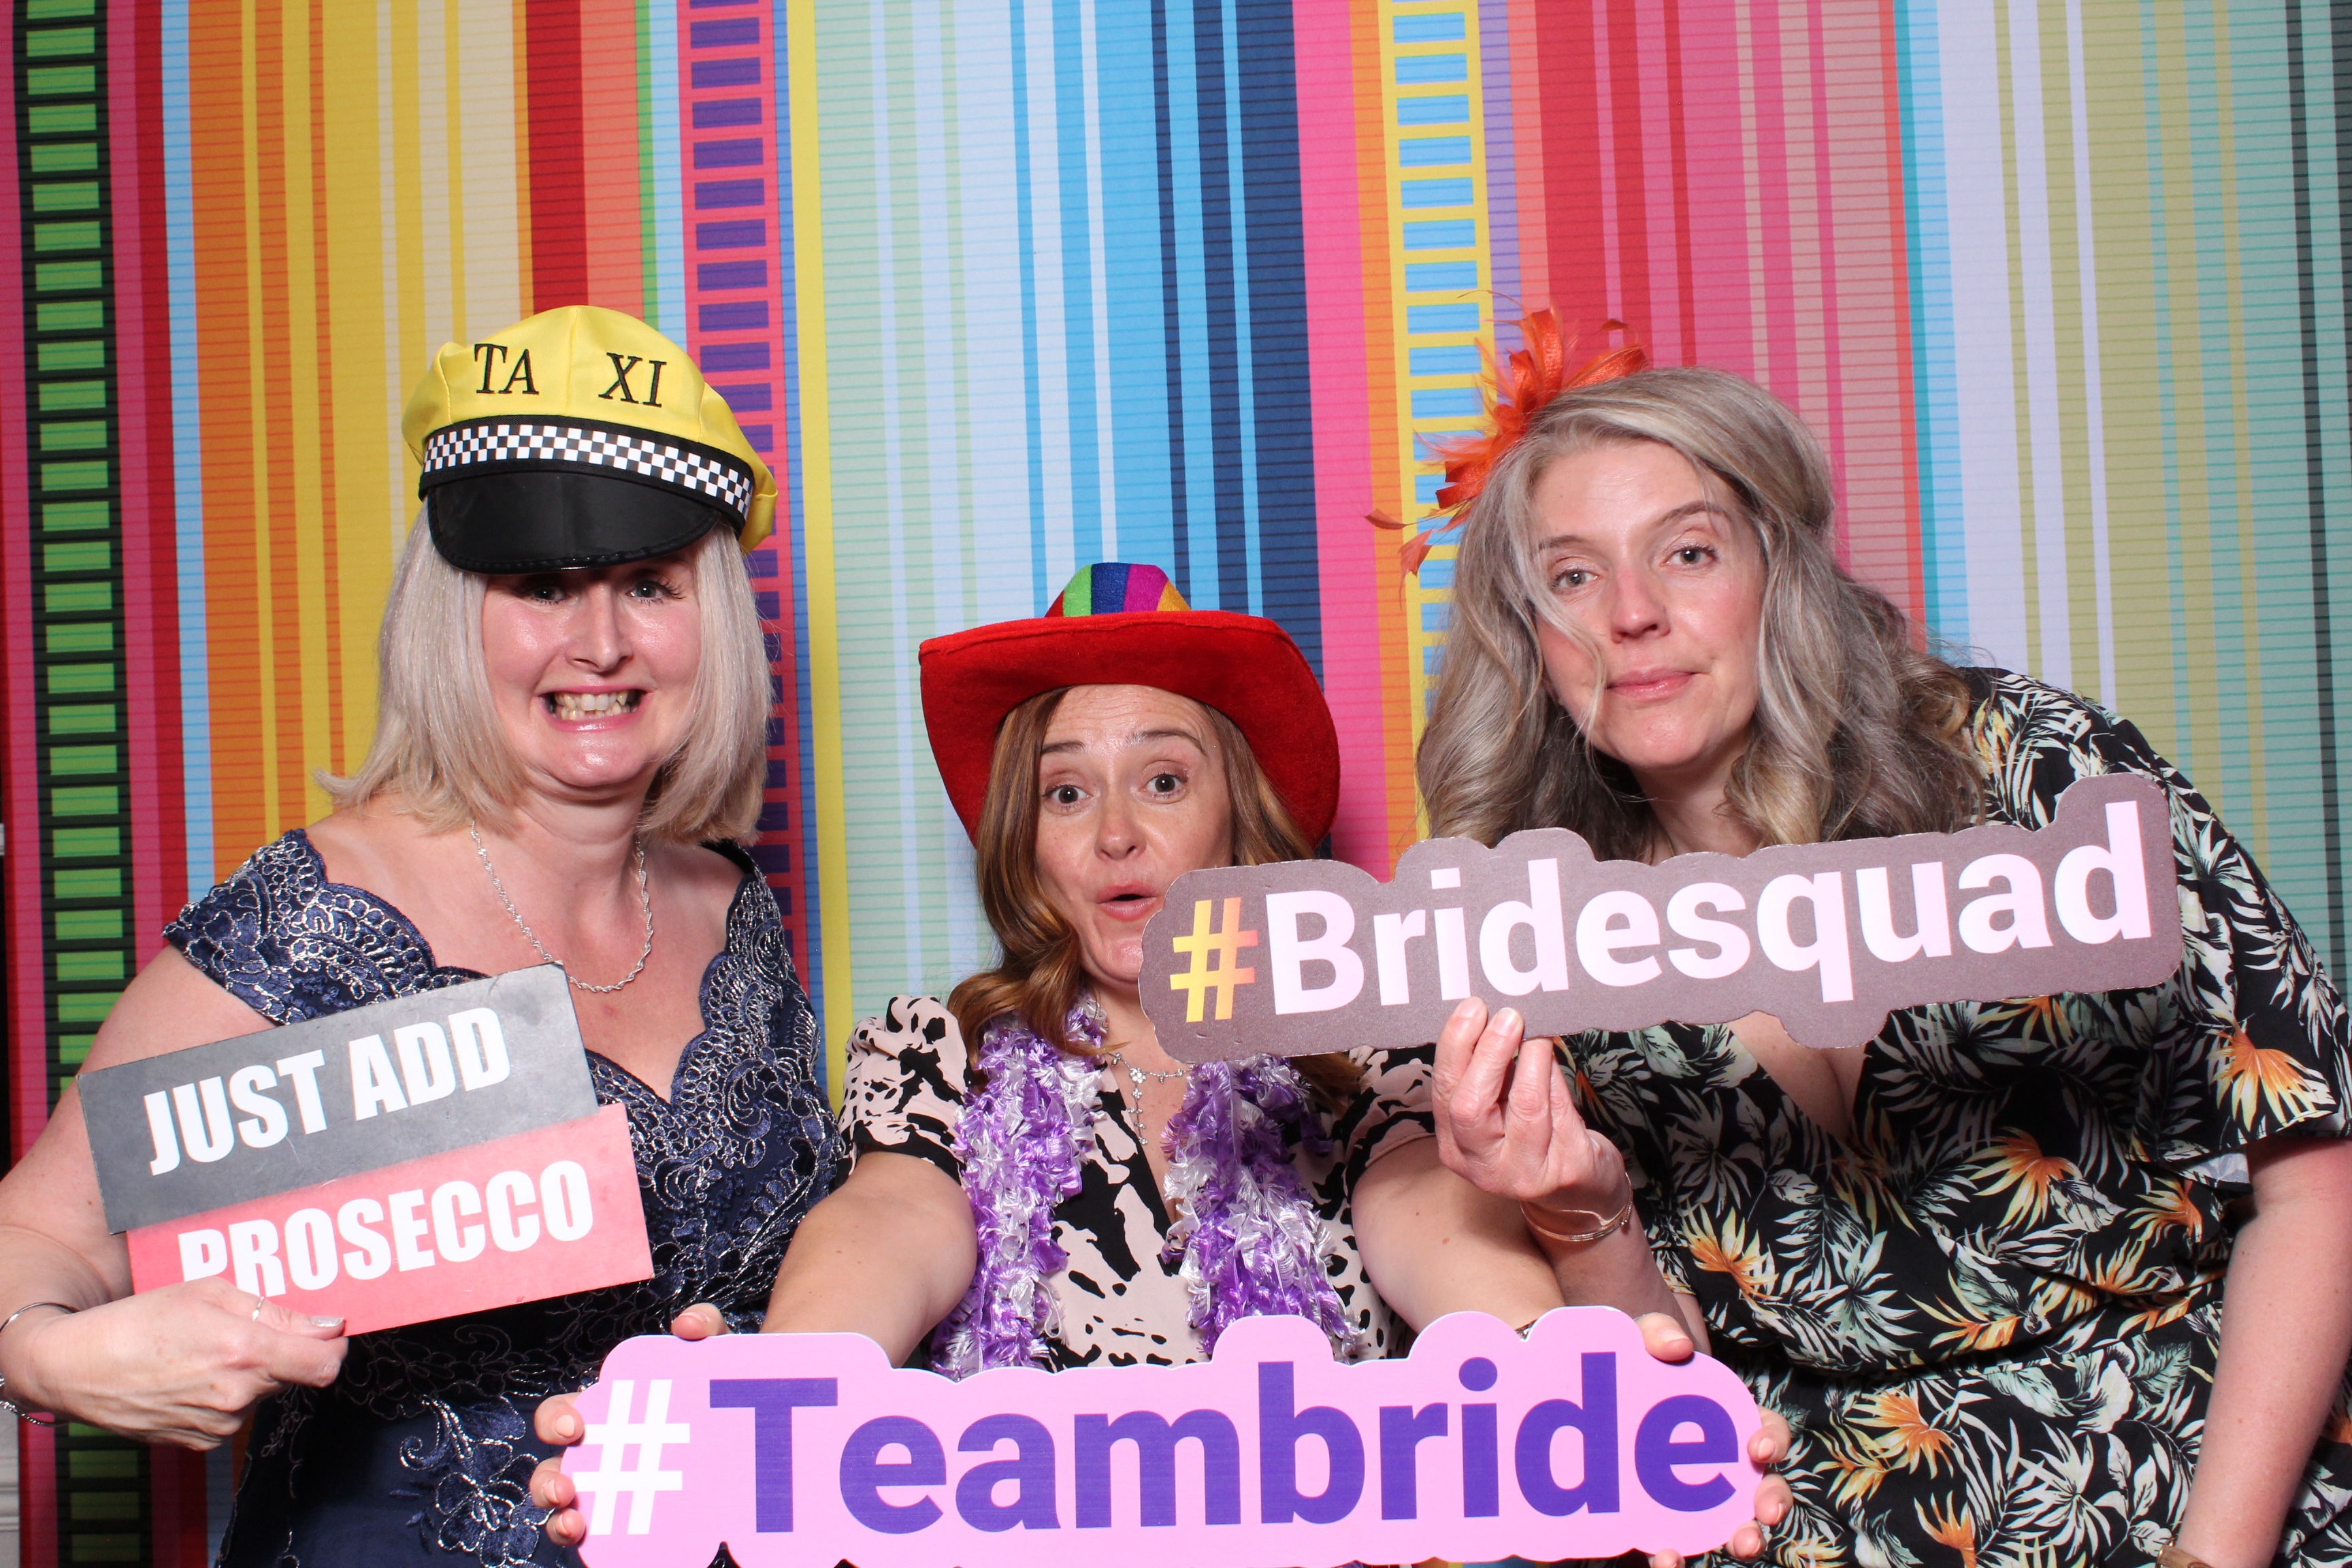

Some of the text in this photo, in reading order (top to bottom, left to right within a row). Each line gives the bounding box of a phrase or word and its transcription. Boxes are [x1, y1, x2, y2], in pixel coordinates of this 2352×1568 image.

[1169, 800, 2152, 1023] #Bridesquad
[144, 1007, 510, 1176] JUST ADD
[178, 1160, 593, 1298] PROSECCO
[572, 1352, 1740, 1534] #Teambride
